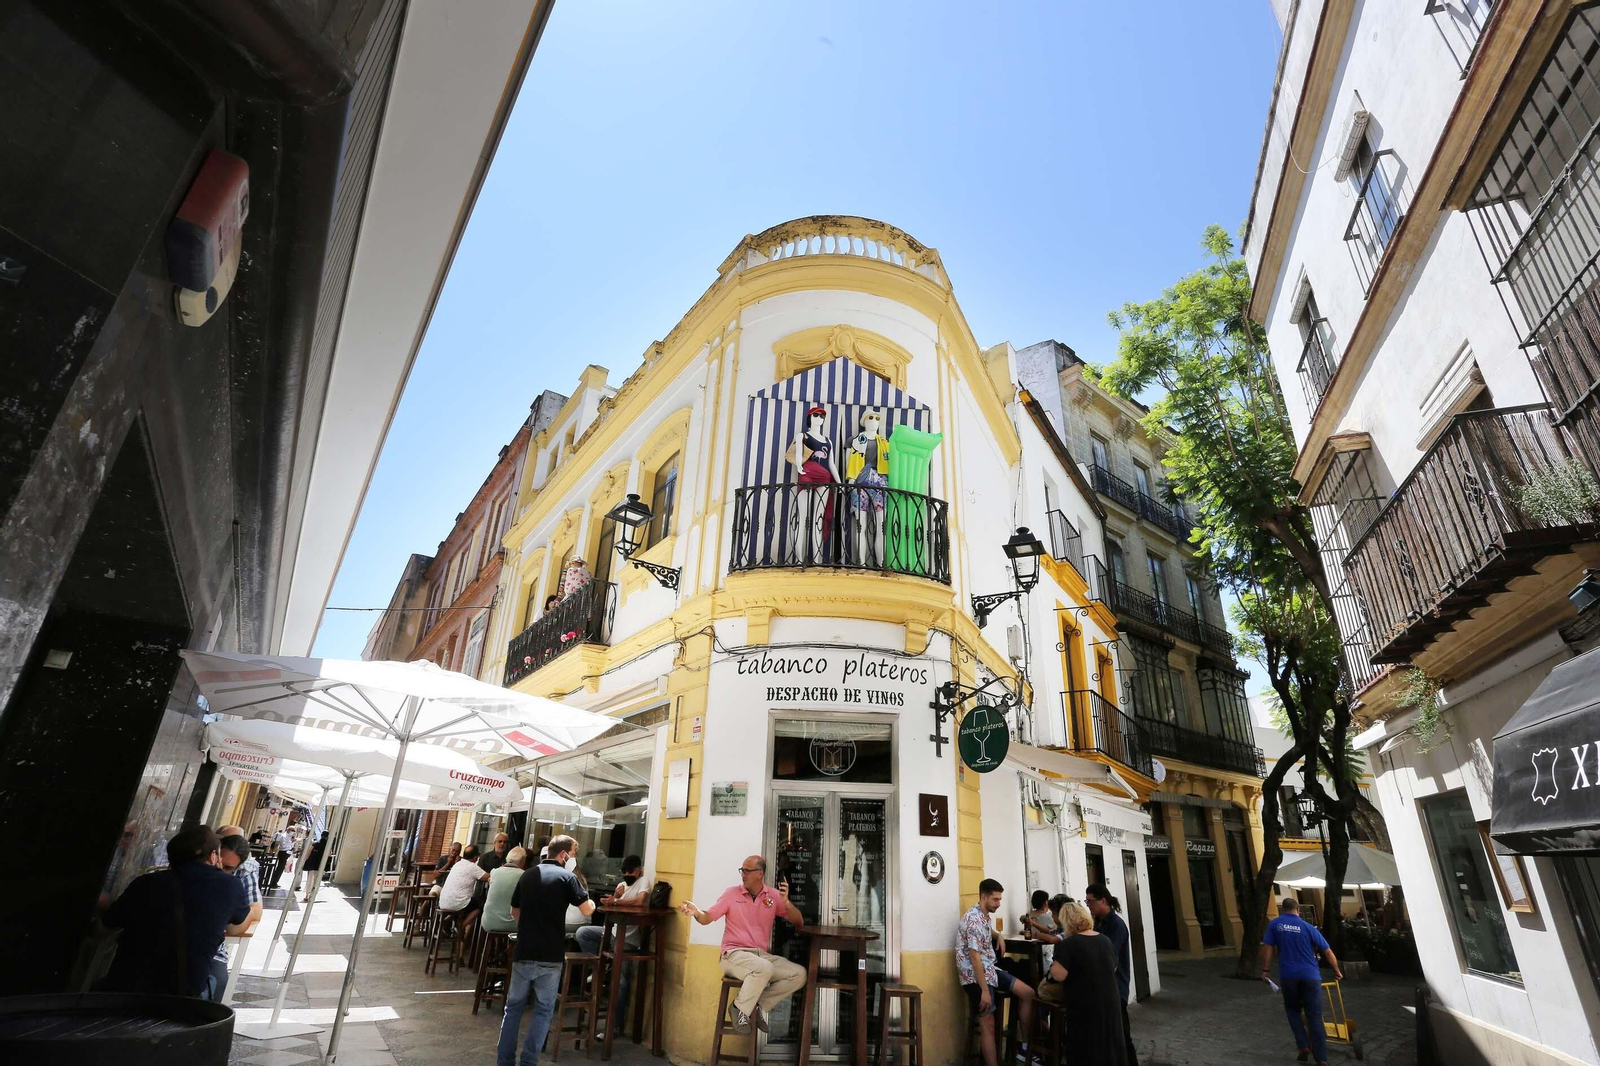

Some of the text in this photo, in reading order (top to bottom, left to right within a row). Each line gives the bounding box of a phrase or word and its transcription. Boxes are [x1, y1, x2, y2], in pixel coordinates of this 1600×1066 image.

[737, 651, 928, 685] tabanco plateros
[766, 687, 905, 706] DESPACHO DE VINOS
[961, 722, 1004, 735] tabanco plateros
[1570, 740, 1600, 790] X
[449, 769, 505, 788] Cruzcampo
[459, 783, 492, 794] ESPECIAL
[788, 809, 814, 819] TABANCO
[850, 812, 875, 821] TABANCO
[848, 823, 876, 832] PLATEROS
[1144, 839, 1215, 855] alerias Ragaza
